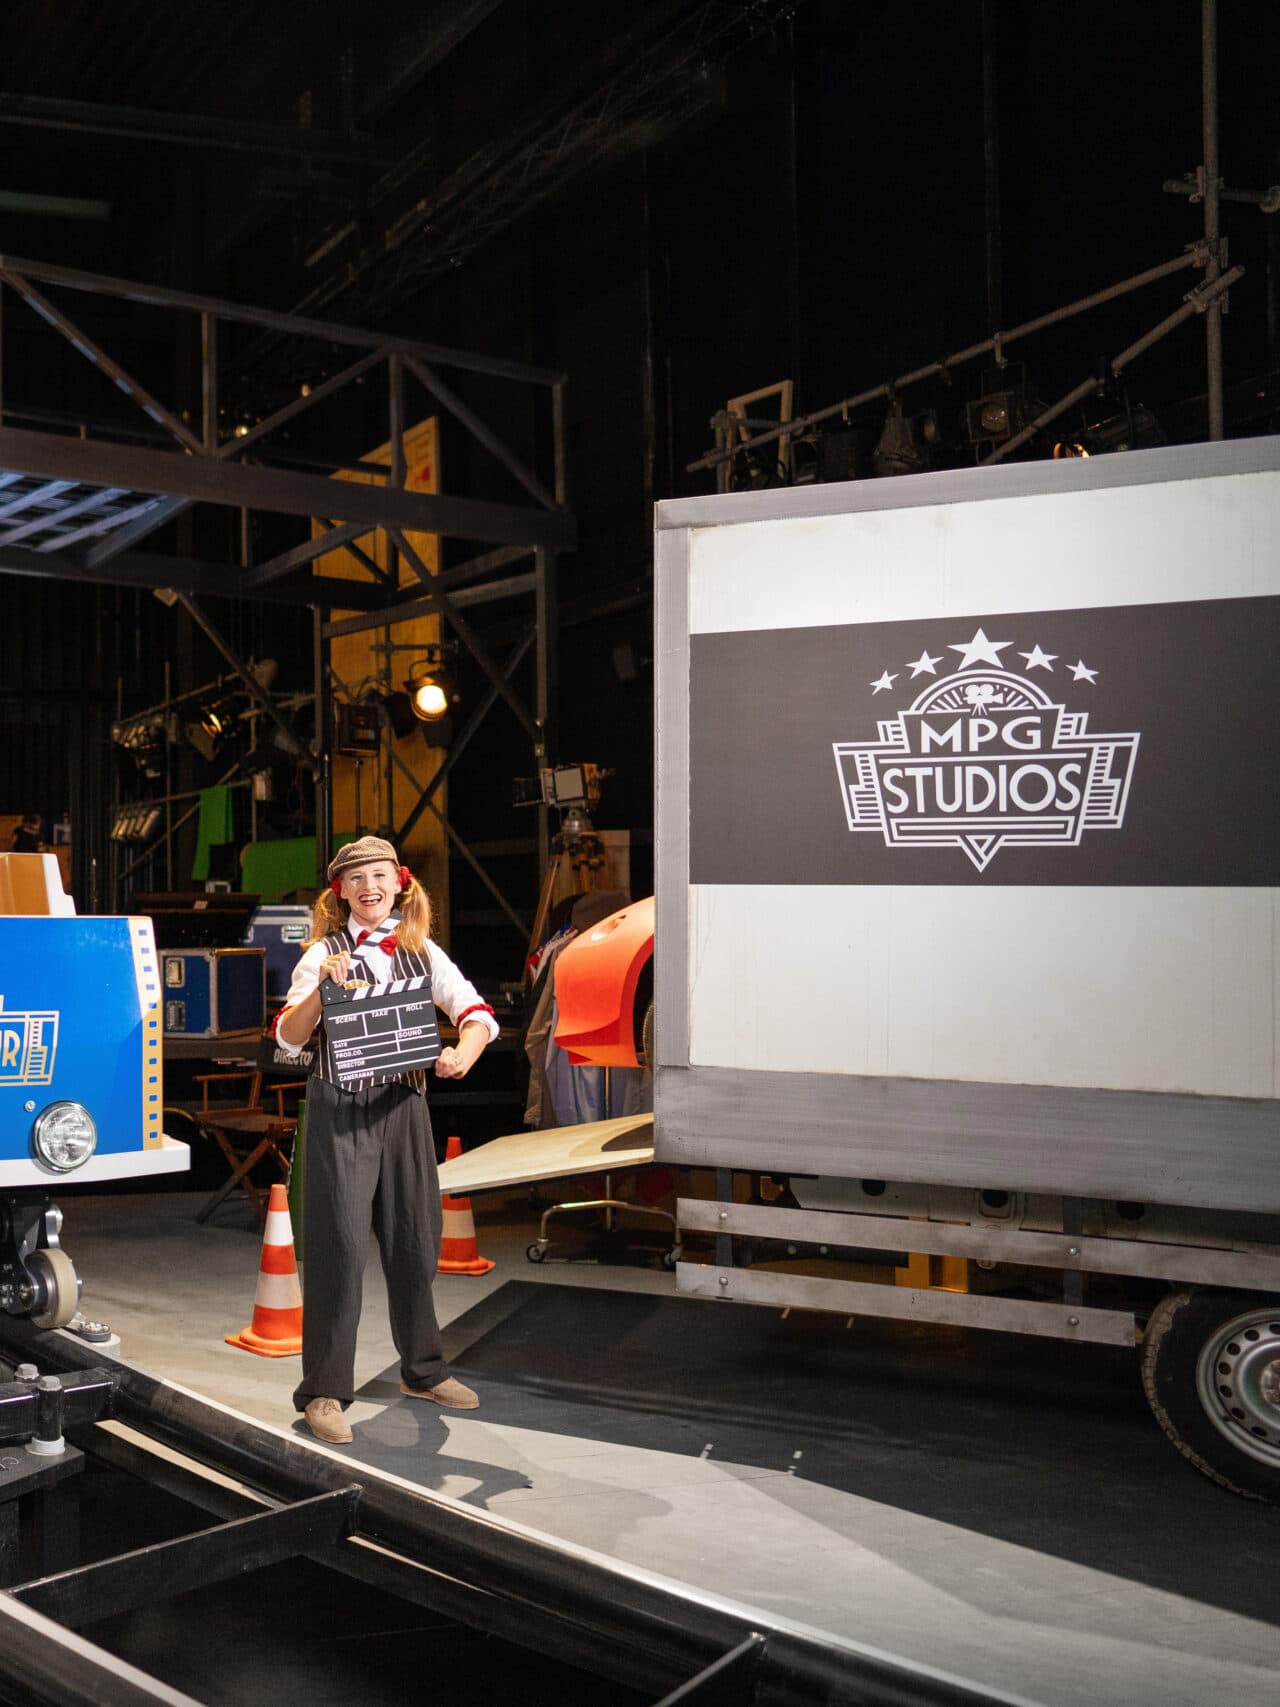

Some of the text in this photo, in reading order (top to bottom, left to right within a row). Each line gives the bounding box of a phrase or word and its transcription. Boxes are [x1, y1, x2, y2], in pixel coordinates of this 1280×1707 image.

[920, 716, 1042, 753] MPG
[882, 763, 1082, 814] STUDIOS
[335, 1003, 424, 1024] SCENE TAKE ROLL
[333, 1029, 422, 1049] DATE SOUND
[337, 1059, 365, 1070] DIRECTOR
[339, 1070, 375, 1082] CAMERAMAN
